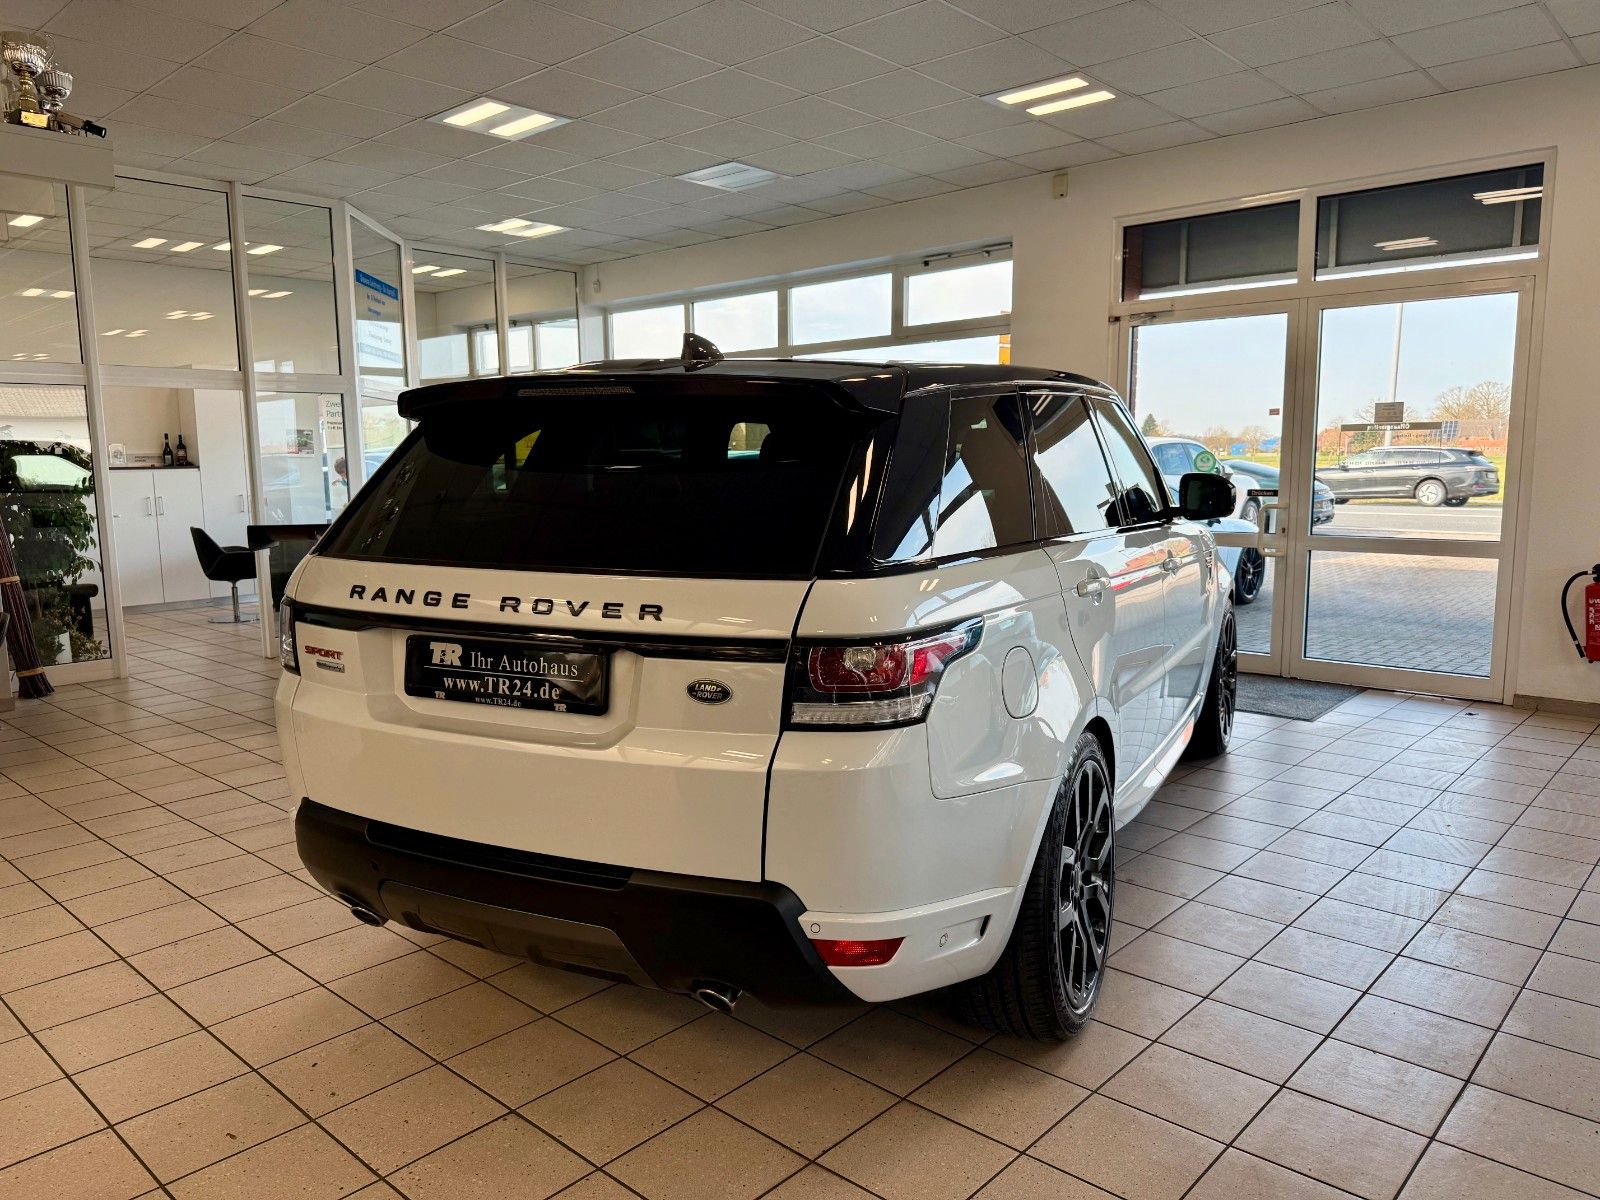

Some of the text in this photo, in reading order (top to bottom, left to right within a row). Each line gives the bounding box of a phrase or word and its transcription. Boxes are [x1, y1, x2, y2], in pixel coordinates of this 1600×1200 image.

[349, 584, 664, 621] RANGE ROVER
[304, 645, 344, 660] SPORT
[470, 651, 579, 677] Ihr Autohaus
[443, 676, 560, 700] www.TR24.de
[694, 683, 717, 692] LAND
[696, 690, 723, 700] ROVER
[475, 697, 522, 708] www.TR24.de
